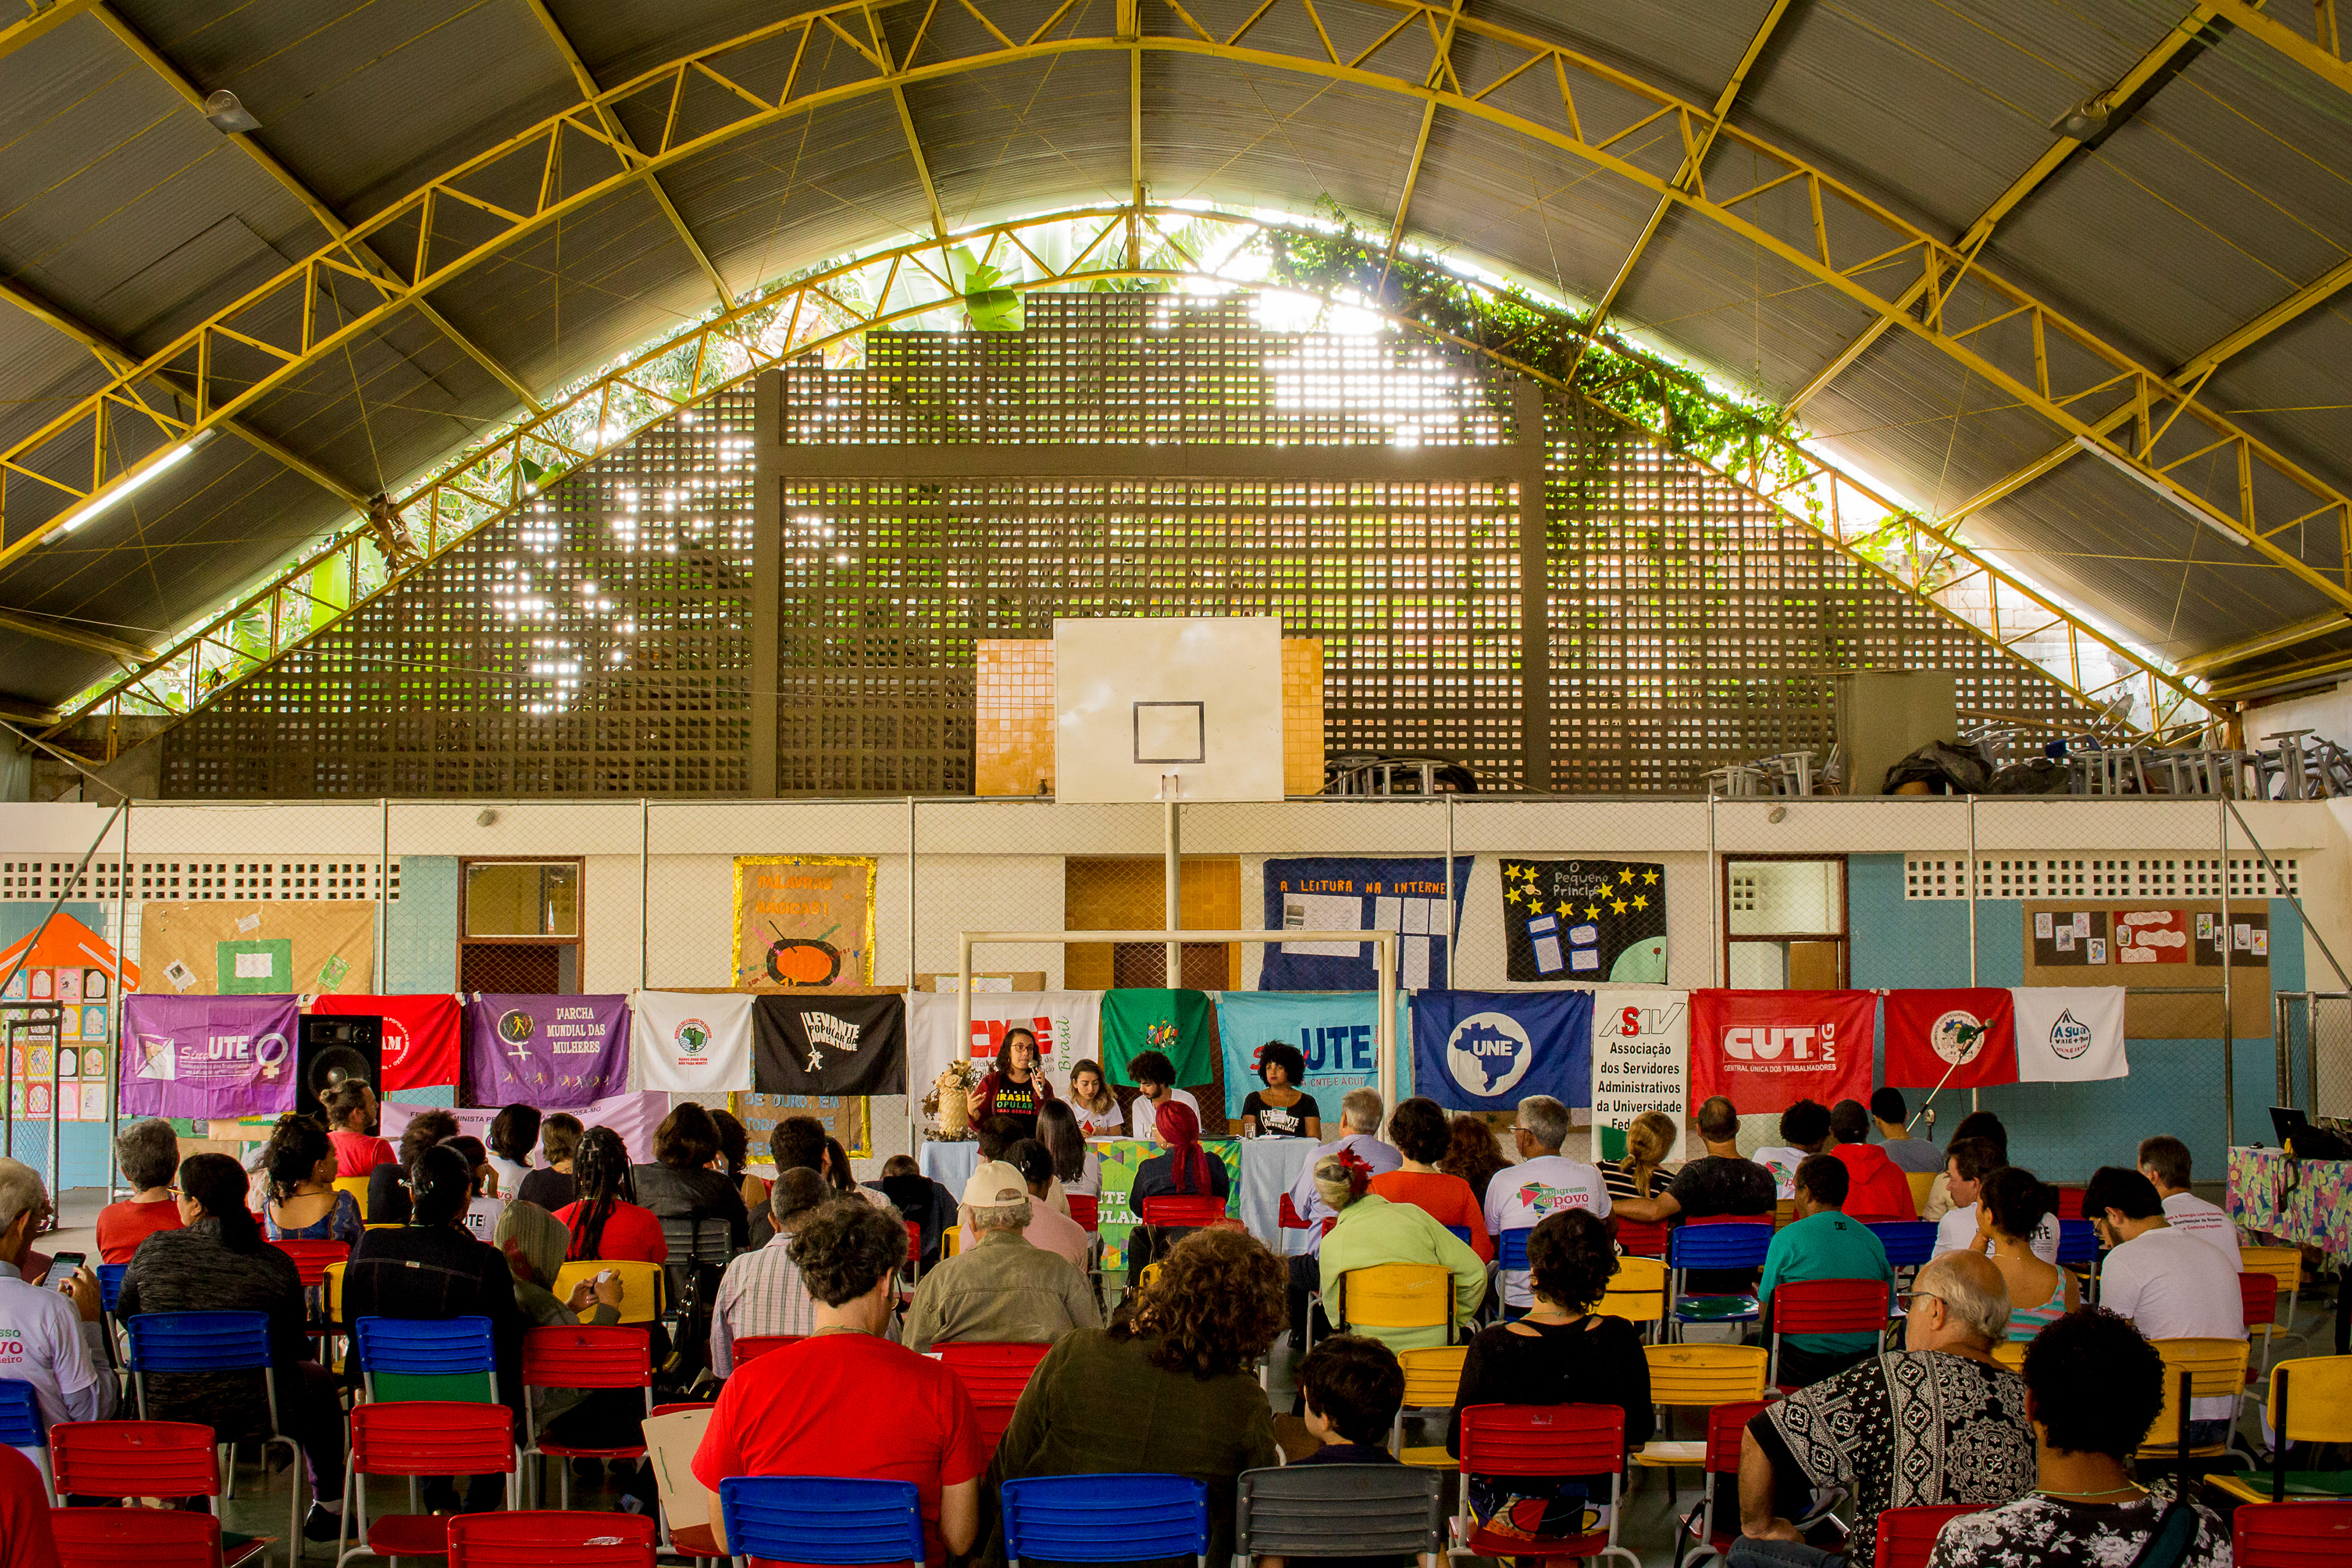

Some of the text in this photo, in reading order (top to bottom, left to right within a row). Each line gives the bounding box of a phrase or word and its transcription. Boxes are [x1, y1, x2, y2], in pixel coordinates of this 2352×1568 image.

[1569, 862, 1580, 873] O
[758, 875, 833, 891] PALAVRAS
[1555, 872, 1608, 886] Pequeno
[1281, 880, 1455, 894] A LEITURA NA INTERNE
[388, 1017, 407, 1033] POPULAR
[2062, 1013, 2070, 1023] A
[546, 1024, 606, 1037] MUNDIAL DAS
[804, 1012, 860, 1039] LEVANTE
[809, 1025, 845, 1042] POPULAR
[553, 1041, 600, 1054] MULHERES
[811, 1031, 858, 1051] JUVENTUDE
[1055, 1016, 1071, 1071] Brasil
[1301, 1025, 1372, 1071] UTE
[1724, 1023, 1835, 1061] CUT MG
[1473, 1041, 1512, 1056] UNE
[1610, 1042, 1671, 1058] Associação
[1600, 1061, 1679, 1074] dos Servidores
[1783, 1063, 1836, 1072] TRABALHADORES
[1310, 1078, 1331, 1087] CNTE
[1597, 1080, 1681, 1093] Administrativos
[745, 1093, 765, 1107] DE
[1597, 1100, 1682, 1112] da Universidade
[1263, 1110, 1299, 1126] LENTE
[1541, 1186, 1587, 1195] Congresso
[1553, 1194, 1589, 1207] povo
